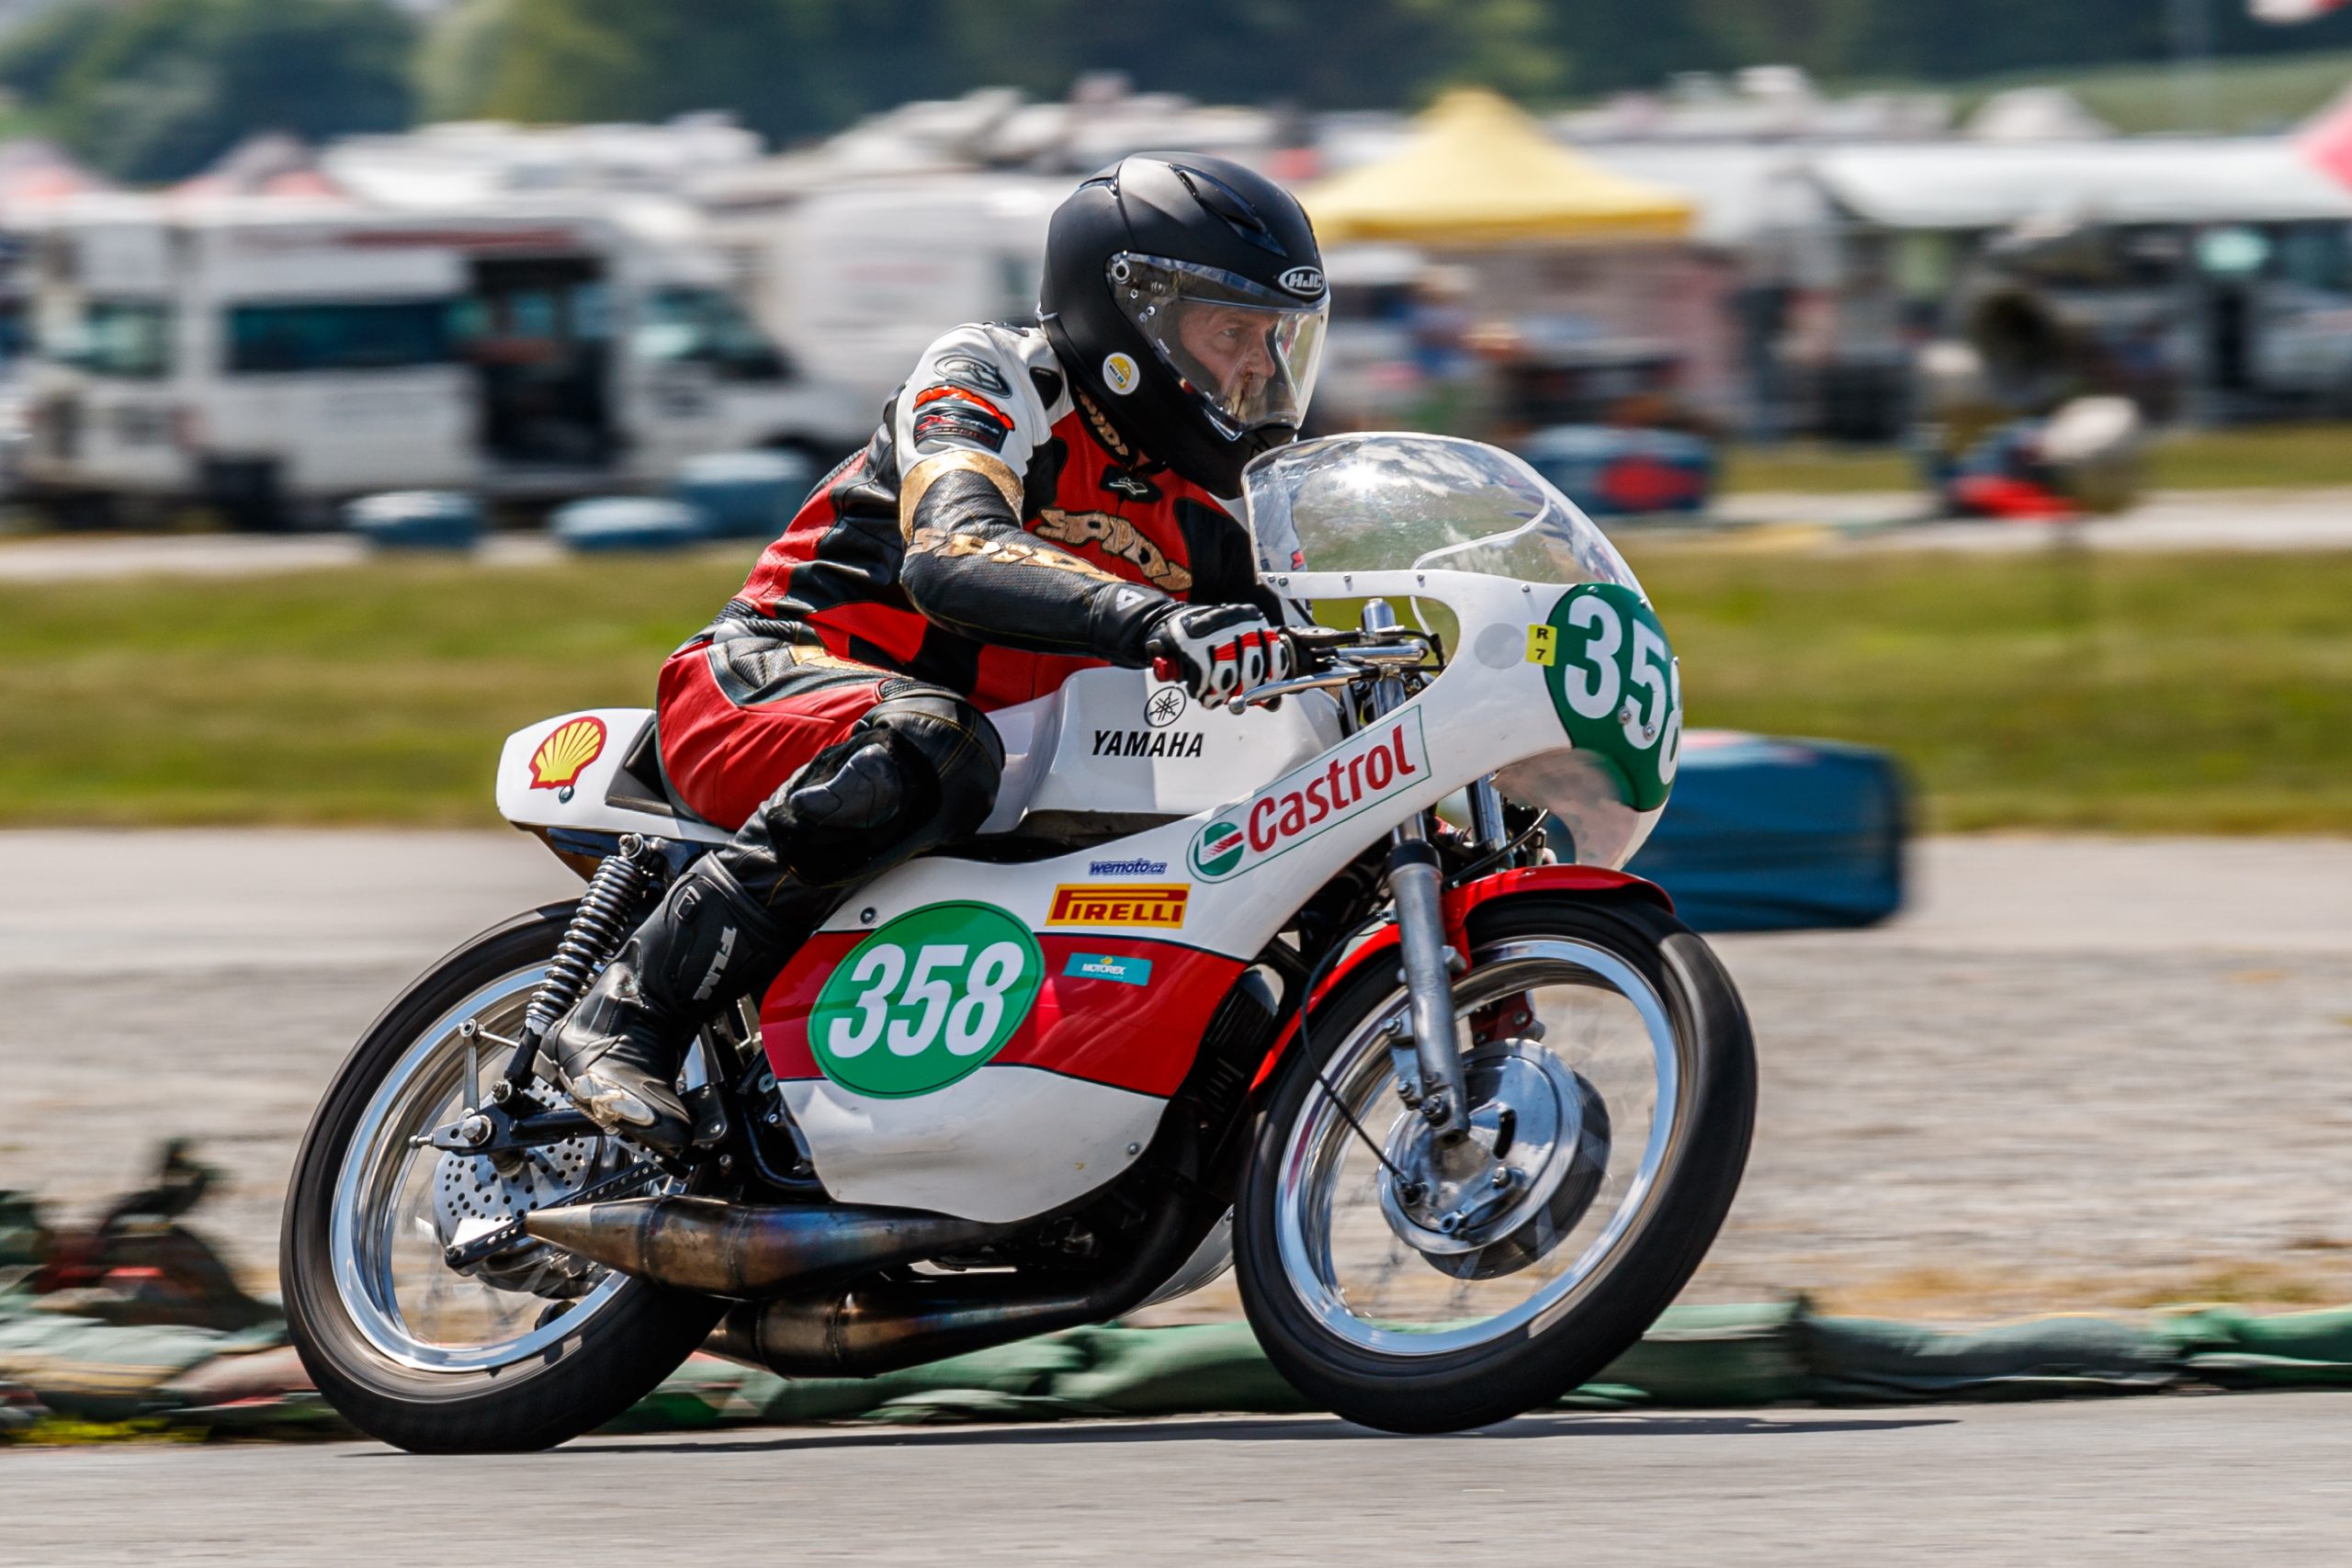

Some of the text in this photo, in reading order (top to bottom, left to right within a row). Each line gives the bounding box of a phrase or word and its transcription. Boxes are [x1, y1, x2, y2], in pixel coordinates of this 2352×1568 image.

[1288, 273, 1322, 288] HJC
[1536, 627, 1549, 640] R
[1535, 649, 1546, 660] 7
[1091, 729, 1204, 758] YAMAHA
[1249, 724, 1416, 852] Castrol
[1090, 859, 1166, 874] wemoto.cz
[1051, 889, 1188, 922] PIRELLI
[693, 926, 737, 1000] FLM
[829, 941, 1024, 1058] 358
